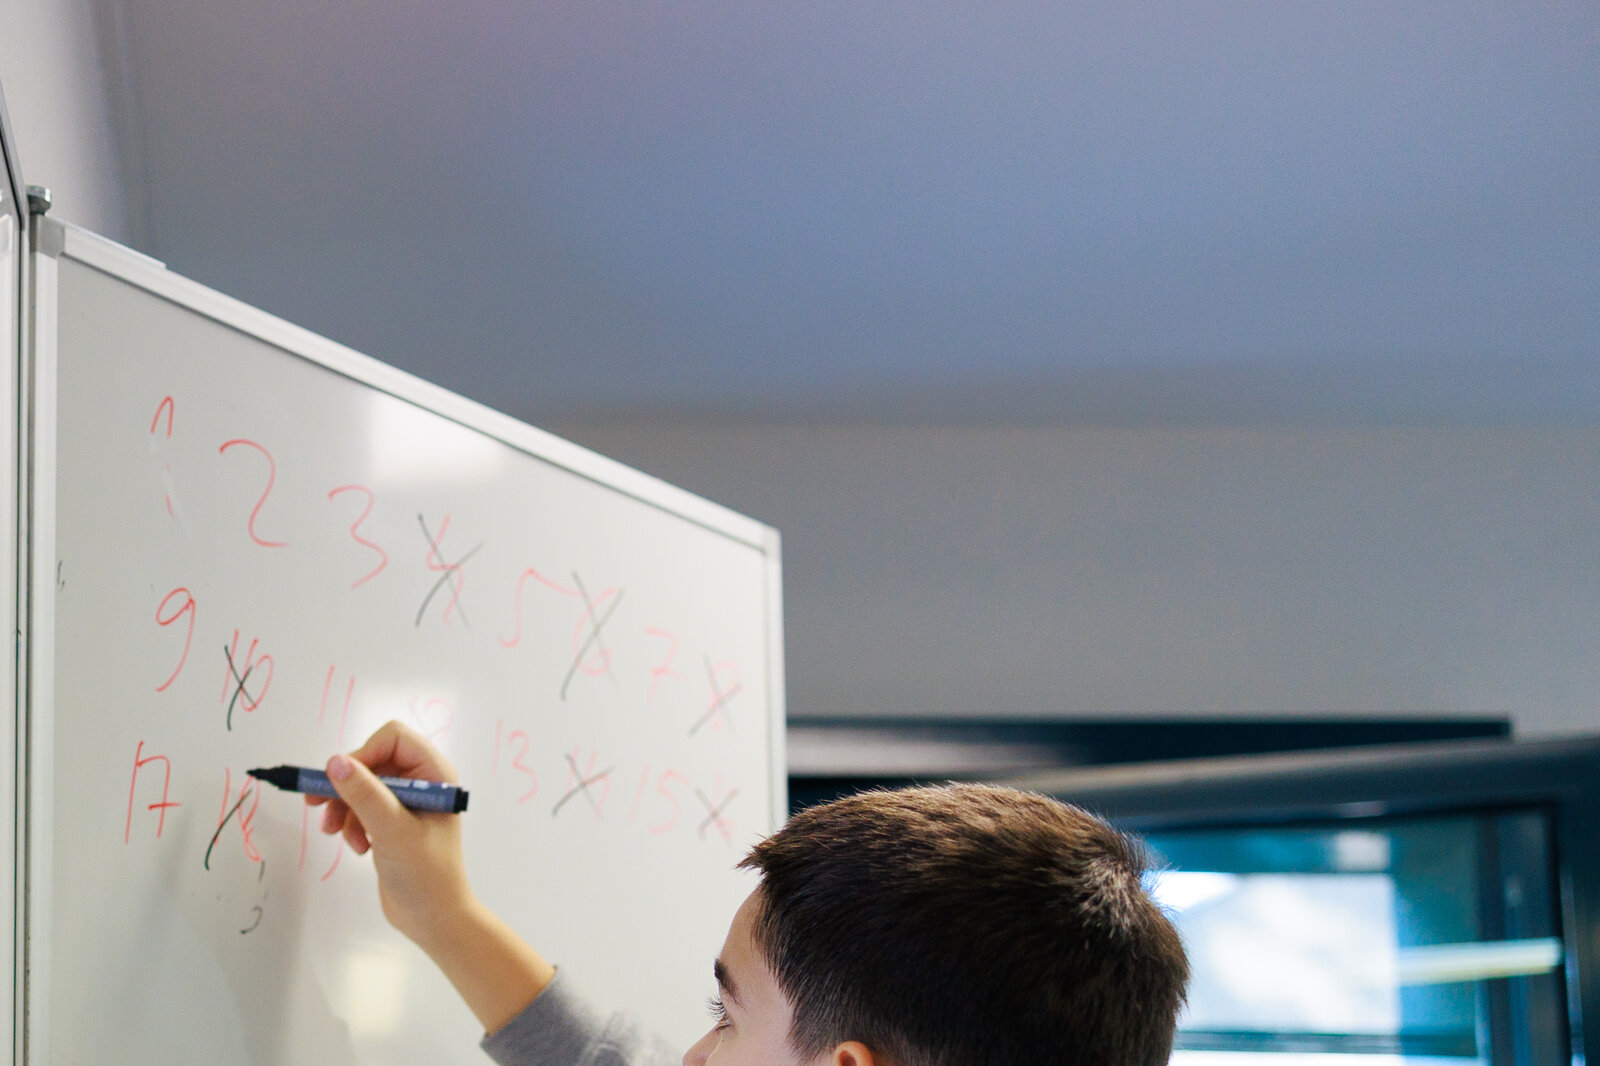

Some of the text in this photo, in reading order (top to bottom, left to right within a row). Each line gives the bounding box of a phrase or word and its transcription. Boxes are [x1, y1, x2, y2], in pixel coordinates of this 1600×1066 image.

[219, 439, 291, 548] 2
[327, 484, 388, 589] 3
[425, 513, 466, 629] 4
[498, 566, 584, 648] 5
[572, 586, 617, 677] 6
[645, 625, 690, 705] 7
[124, 738, 182, 844] 17
[155, 586, 197, 692] 9
[318, 663, 357, 748] 11
[491, 719, 540, 806] 13
[628, 762, 691, 835] 15
